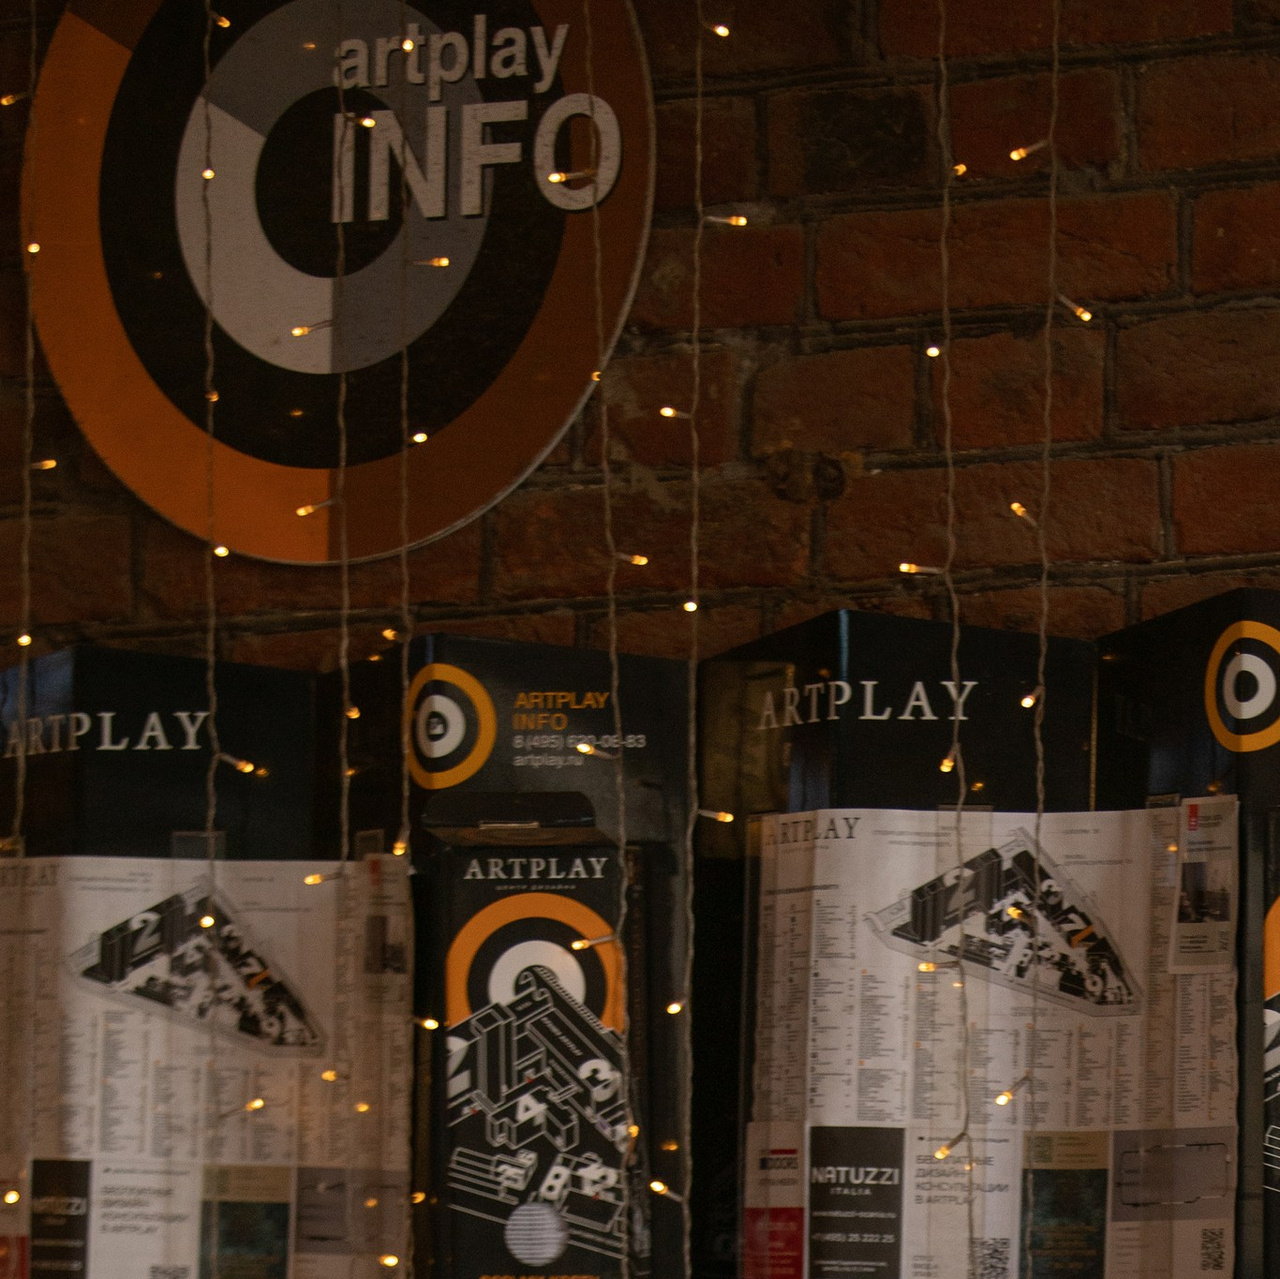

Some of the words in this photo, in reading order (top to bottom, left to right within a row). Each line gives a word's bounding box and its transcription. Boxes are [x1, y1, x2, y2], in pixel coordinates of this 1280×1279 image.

[333, 14, 569, 102] artplay
[331, 93, 621, 223] INFO
[513, 690, 610, 709] ARTPLAY
[756, 680, 979, 730] ARTPLAY
[1, 711, 210, 759] ARTPLAY
[512, 712, 568, 731] INFO
[463, 857, 609, 880] ARTPLAY
[811, 1166, 899, 1185] NATUZZI
